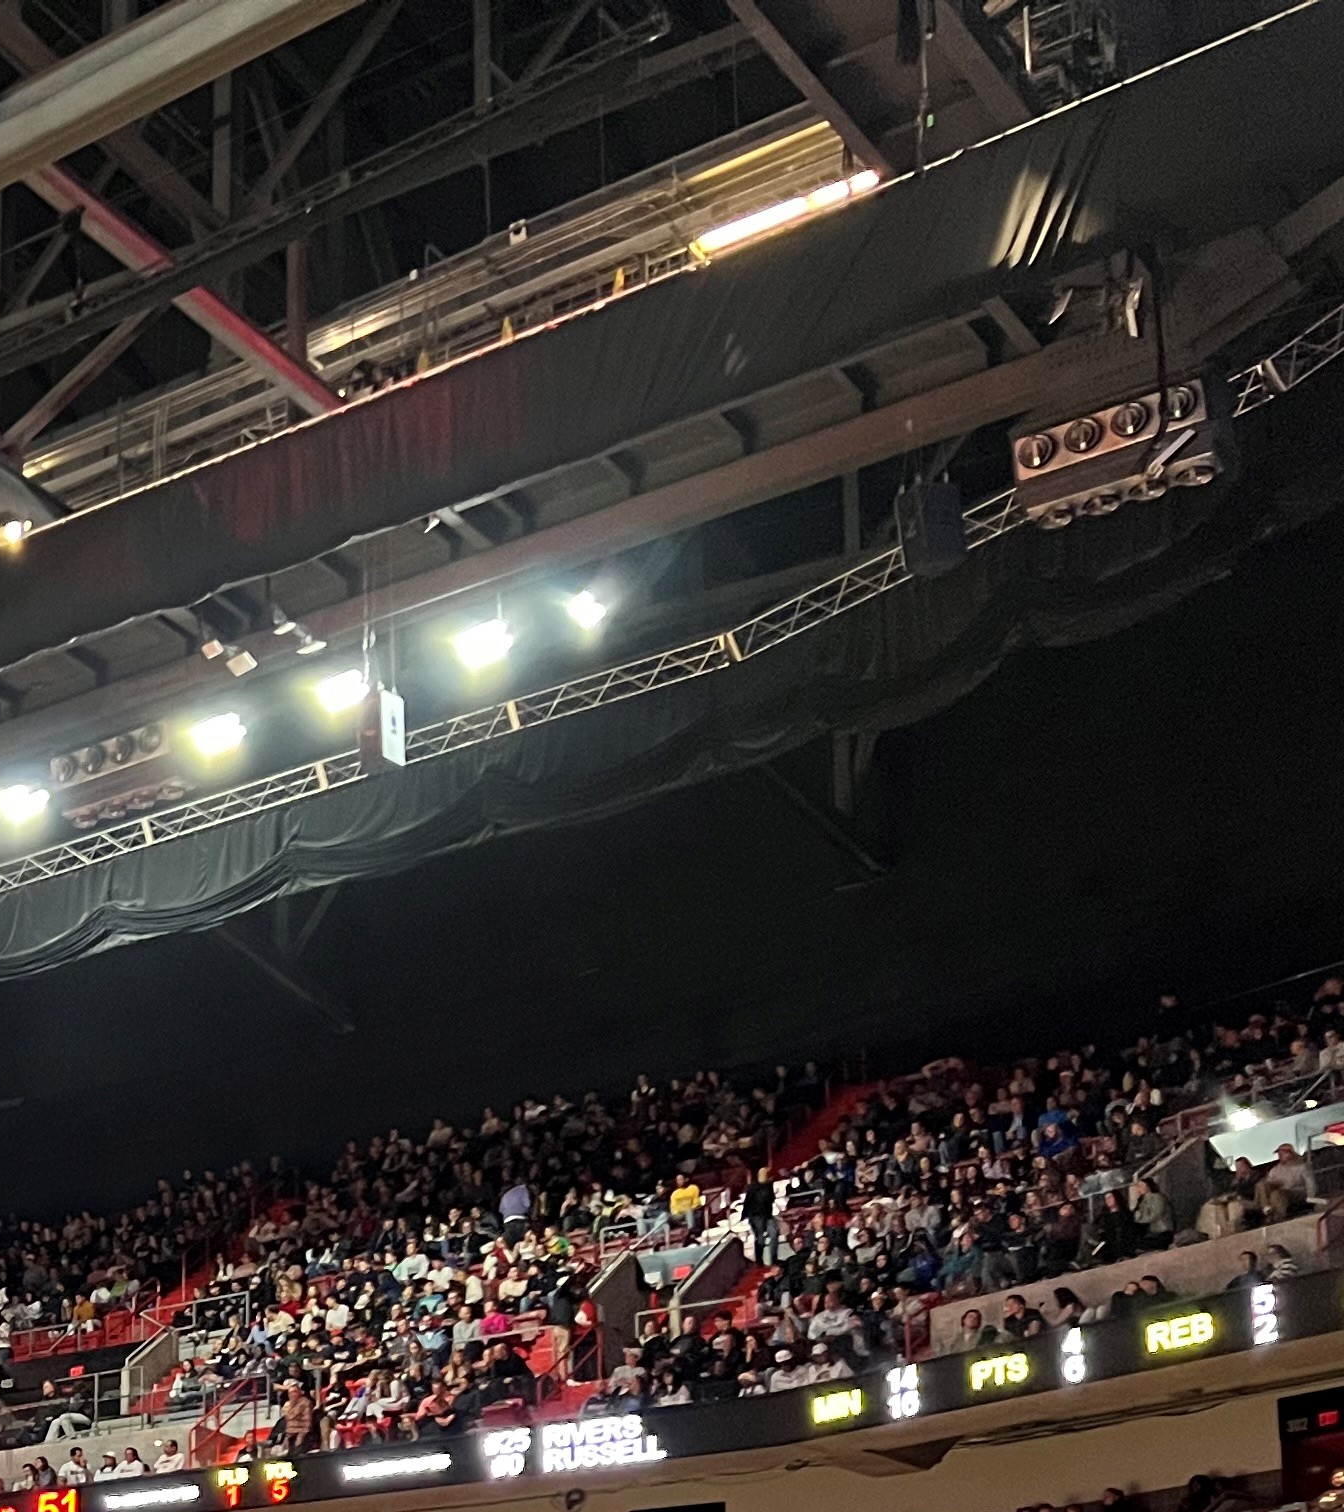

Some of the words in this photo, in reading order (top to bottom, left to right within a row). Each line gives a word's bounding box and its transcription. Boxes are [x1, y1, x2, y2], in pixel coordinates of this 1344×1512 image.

[1252, 1284, 1275, 1314] 5
[1062, 1328, 1083, 1354] 4
[1146, 1313, 1213, 1353] REB
[1253, 1314, 1278, 1345] 2
[886, 1364, 919, 1393] 14
[971, 1354, 1029, 1390] PTS
[542, 1414, 643, 1449] RIVERS
[542, 1435, 668, 1473] RUSSELL
[271, 1479, 288, 1501] 5
